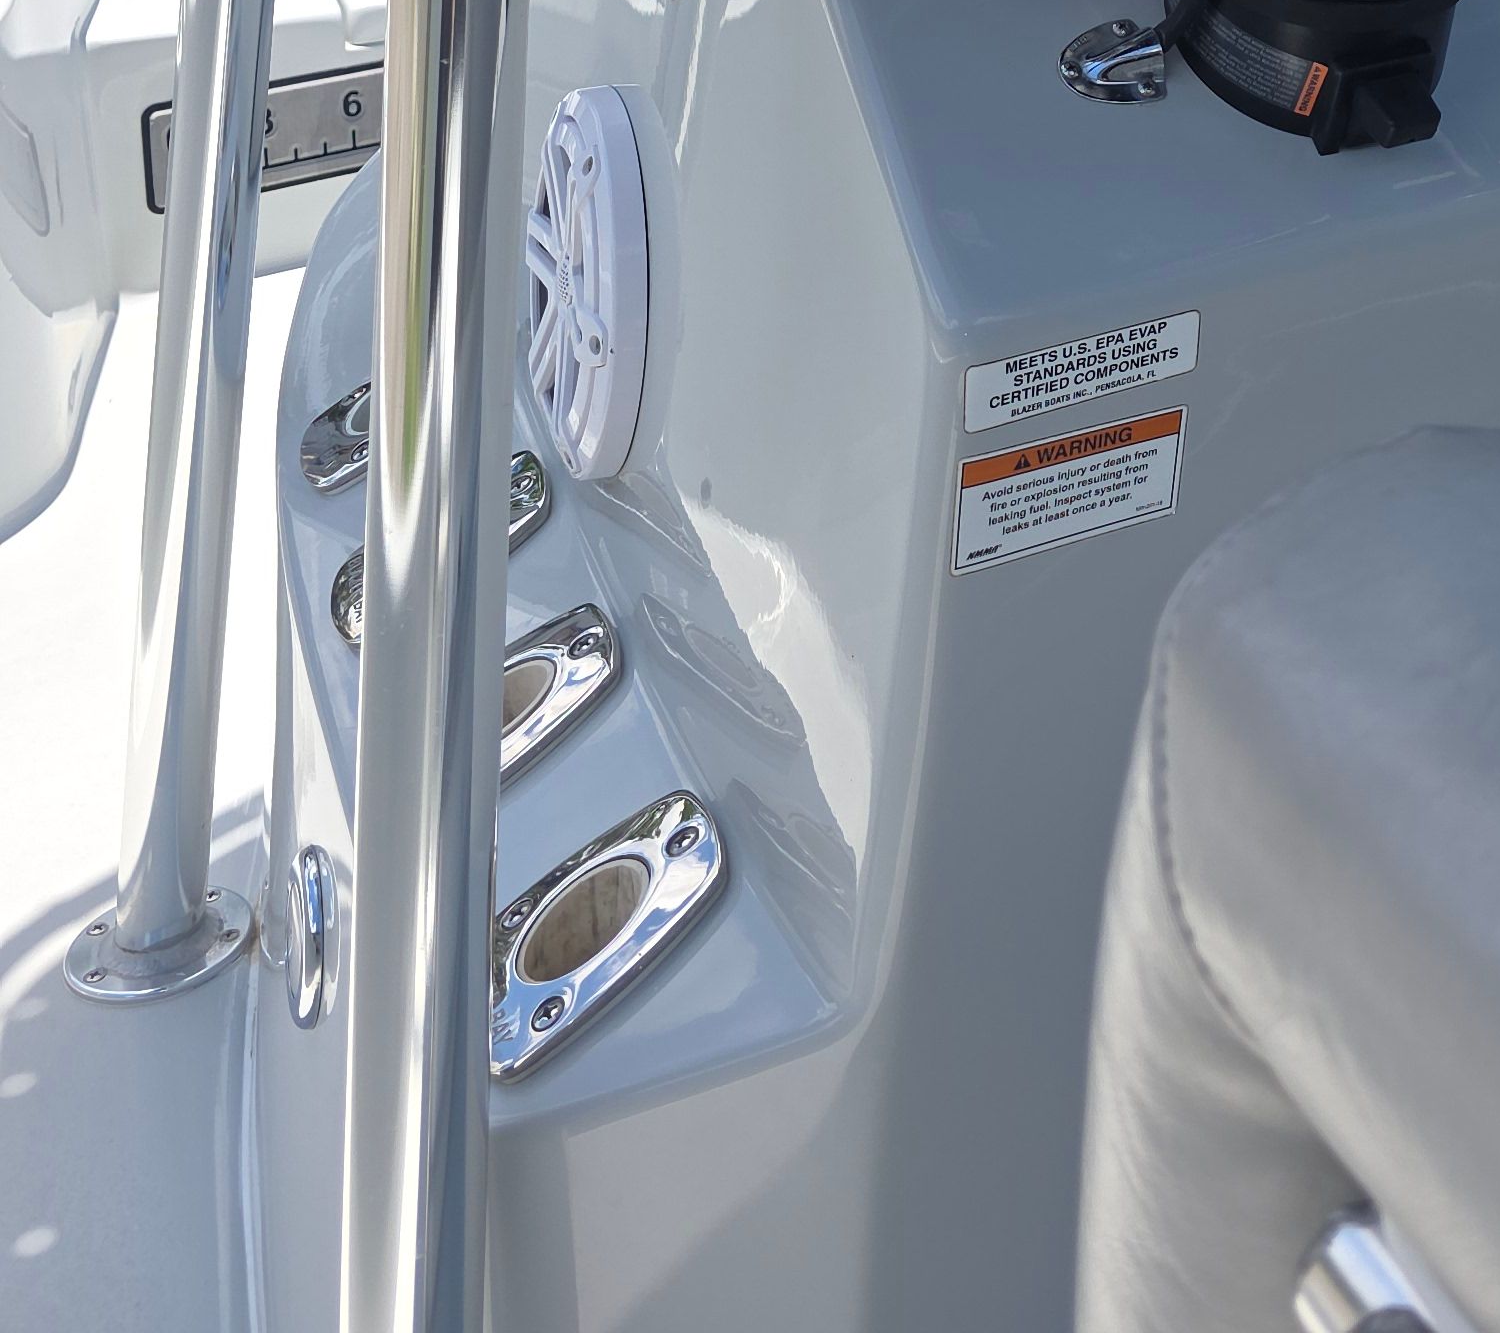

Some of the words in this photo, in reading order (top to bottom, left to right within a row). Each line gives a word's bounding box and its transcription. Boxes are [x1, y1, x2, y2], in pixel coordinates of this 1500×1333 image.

[343, 90, 363, 117] 6
[1298, 71, 1320, 112] WARNING
[1005, 349, 1058, 375] MEETS
[1062, 342, 1091, 359] U.S.
[1095, 334, 1125, 351] EPA
[1128, 321, 1168, 342] EVAP
[1013, 354, 1107, 388] STANDARDS
[1111, 338, 1158, 361] USING
[989, 377, 1070, 409] CERTIFIED
[1073, 347, 1179, 386] COMPONENTS
[1011, 401, 1043, 418] BLAZER
[1044, 393, 1071, 408] BOATS
[1095, 373, 1145, 394] PENSACOLA,
[1146, 369, 1157, 379] FL
[1036, 427, 1133, 465] WARNING
[981, 484, 1013, 502] Avoid
[1015, 474, 1055, 494] serious
[1057, 466, 1087, 481] injury
[1089, 462, 1101, 472] or
[1103, 453, 1132, 469] death
[1133, 447, 1158, 461] from
[989, 500, 1008, 513] fire
[1010, 497, 1022, 507] or
[1024, 482, 1075, 504] explosion
[1077, 468, 1123, 489] resulting
[1124, 462, 1149, 477] from
[988, 507, 1027, 527] leaking
[1028, 500, 1051, 515] fuel.
[1054, 489, 1092, 509] Inspect
[1094, 481, 1131, 498] system
[1133, 474, 1149, 487] for
[1001, 520, 1030, 536] leaks
[1031, 516, 1043, 526] at
[1044, 508, 1070, 524] least
[1071, 502, 1098, 515] once
[1099, 500, 1106, 508] a
[1108, 491, 1133, 509] year.
